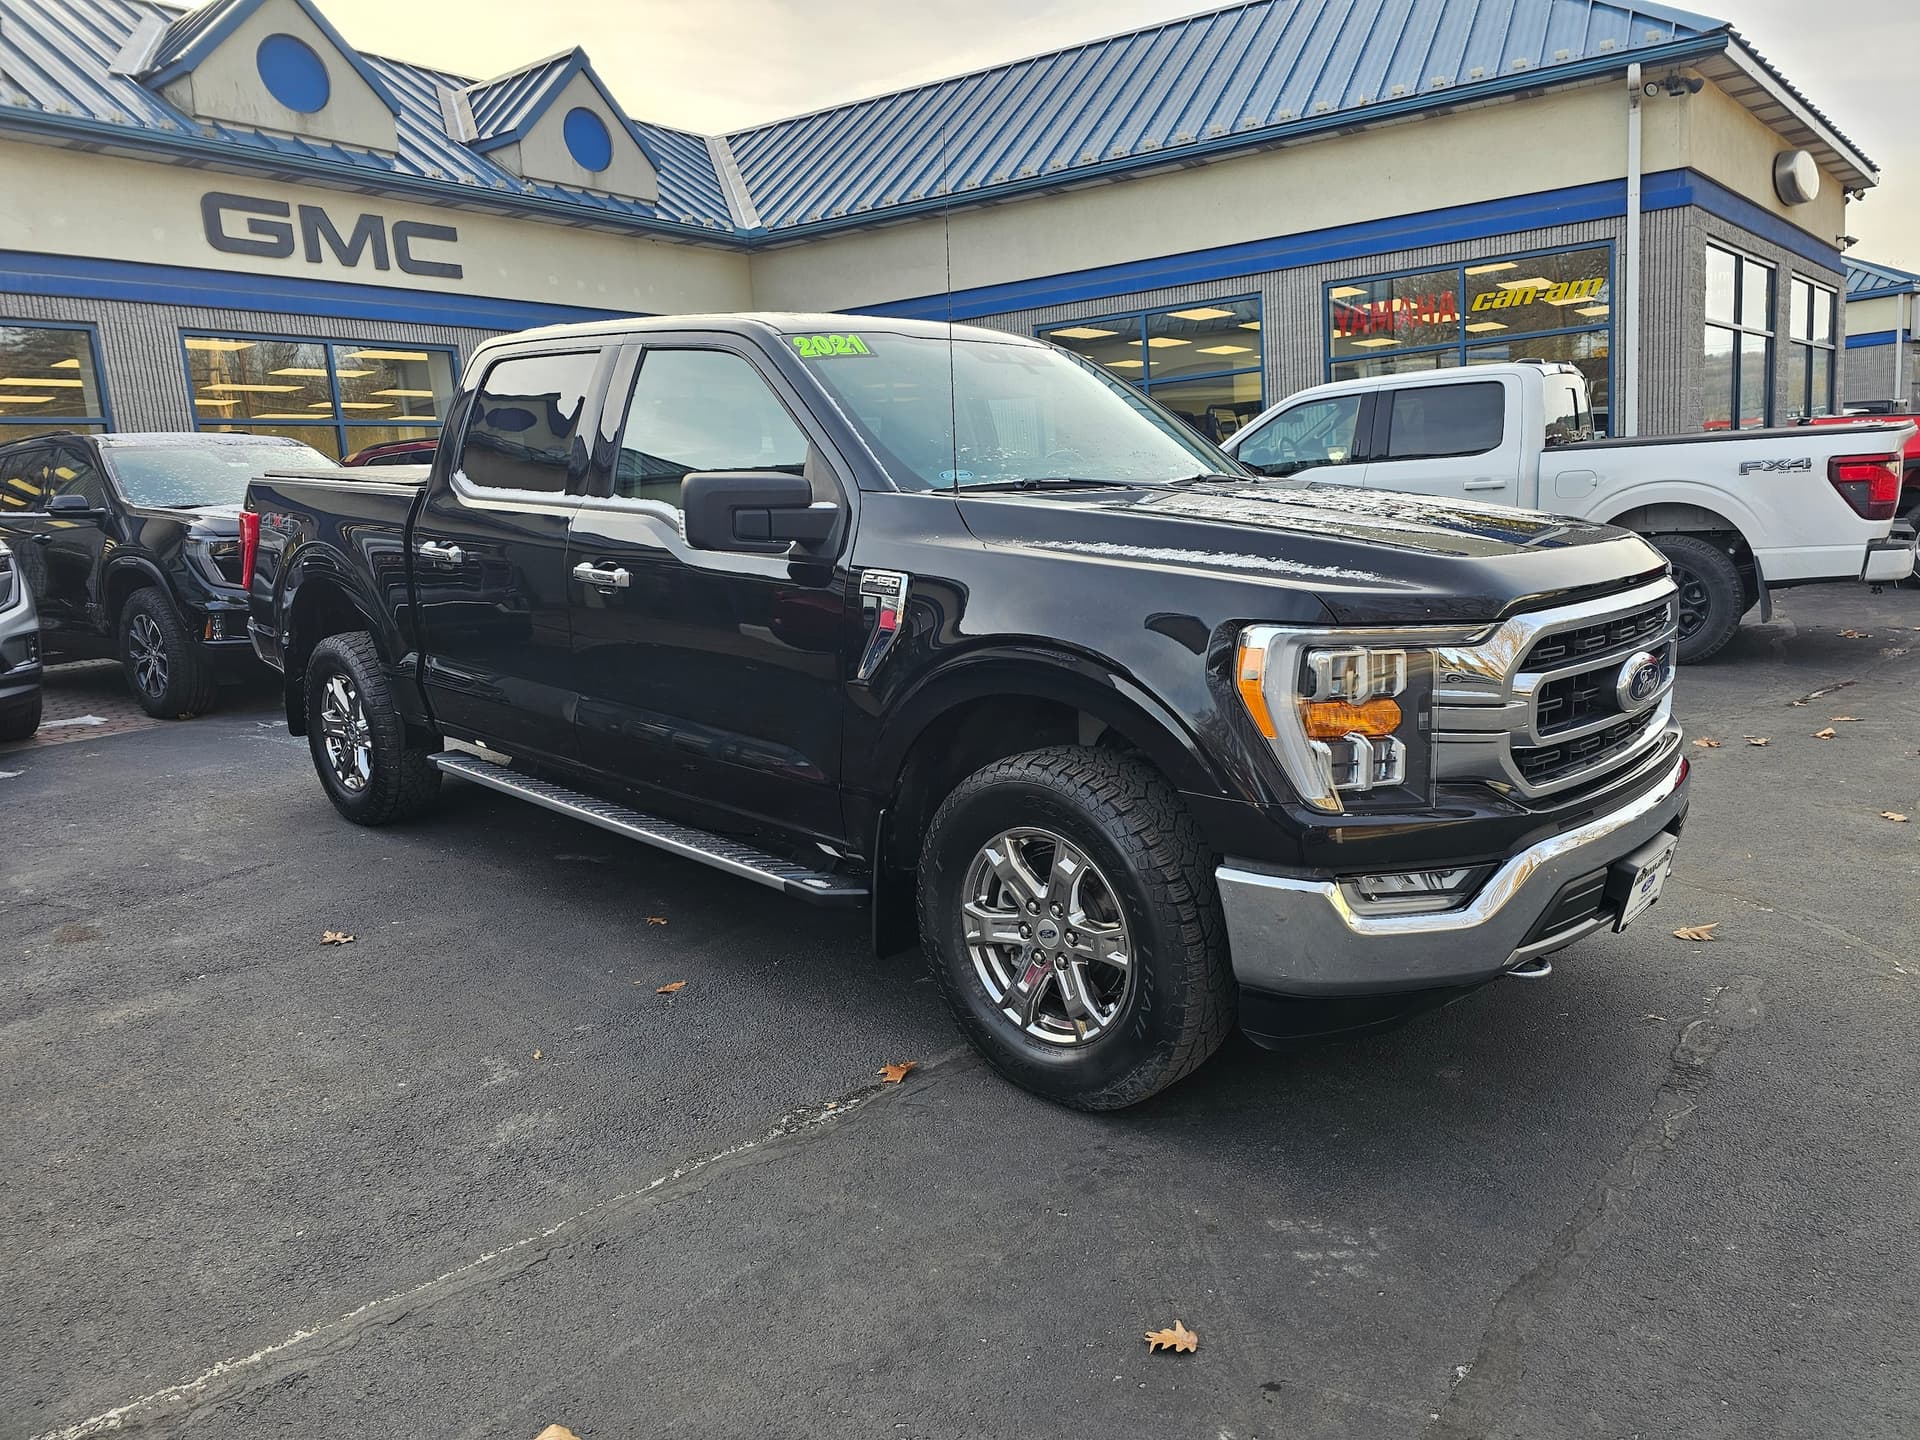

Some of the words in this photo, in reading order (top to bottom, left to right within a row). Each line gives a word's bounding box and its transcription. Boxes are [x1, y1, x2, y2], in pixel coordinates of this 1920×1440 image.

[201, 191, 463, 280] GMC
[1471, 277, 1605, 312] can-am
[1334, 290, 1457, 337] YAMAHA
[793, 334, 871, 358] 2021
[1739, 457, 1812, 475] FX4
[863, 574, 900, 588] F-150
[1637, 667, 1657, 695] Ford
